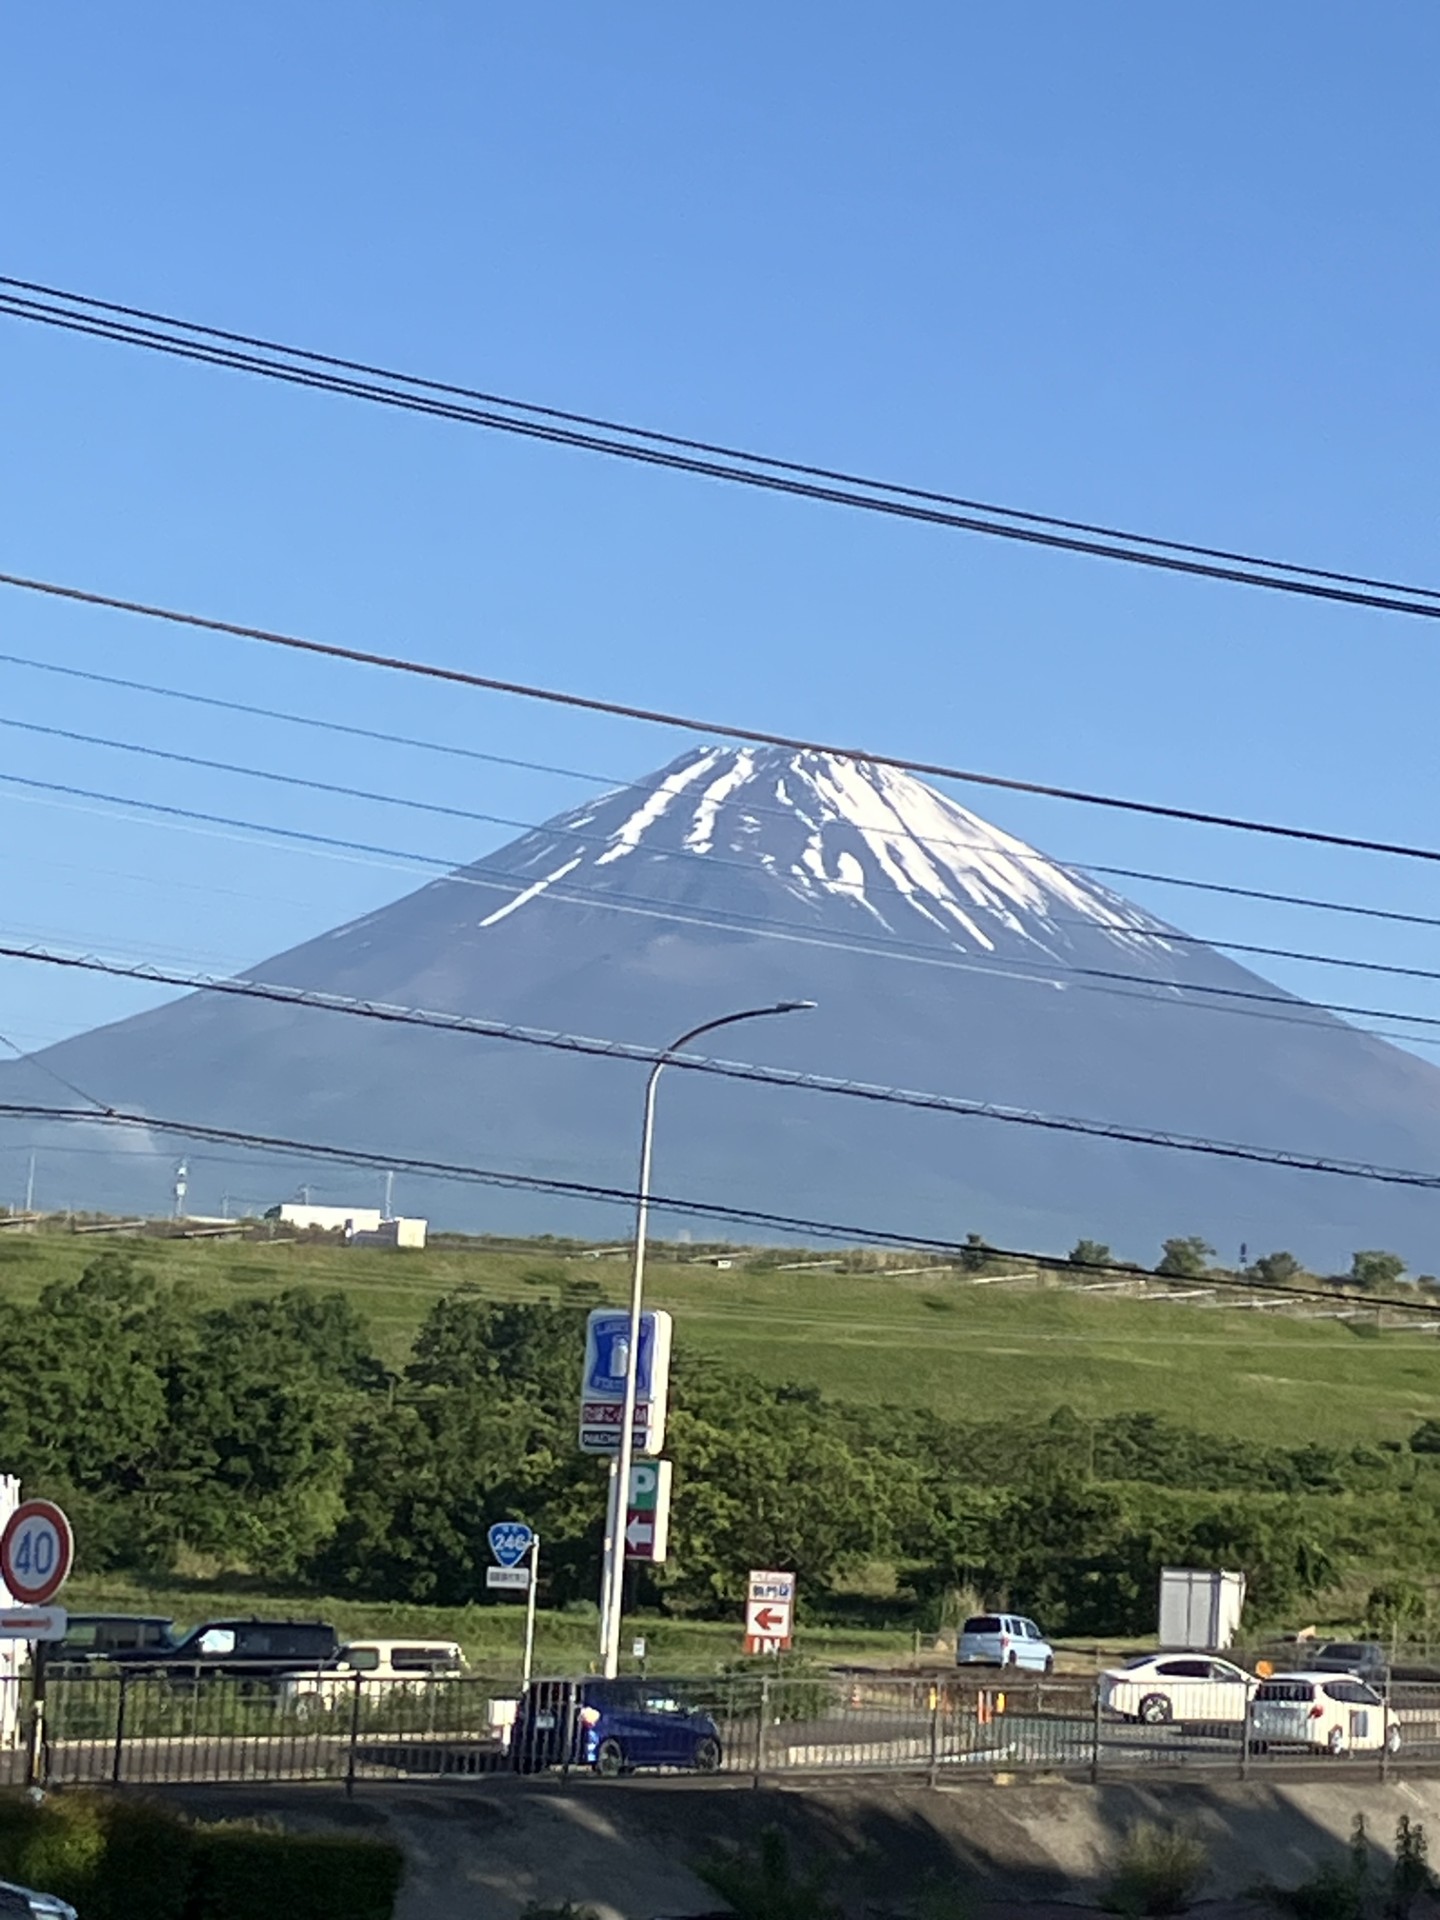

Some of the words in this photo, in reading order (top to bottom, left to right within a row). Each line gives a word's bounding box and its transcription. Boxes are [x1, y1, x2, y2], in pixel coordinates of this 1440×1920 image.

[629, 1466, 656, 1505] P
[15, 1530, 53, 1574] 40
[494, 1533, 526, 1550] 246
